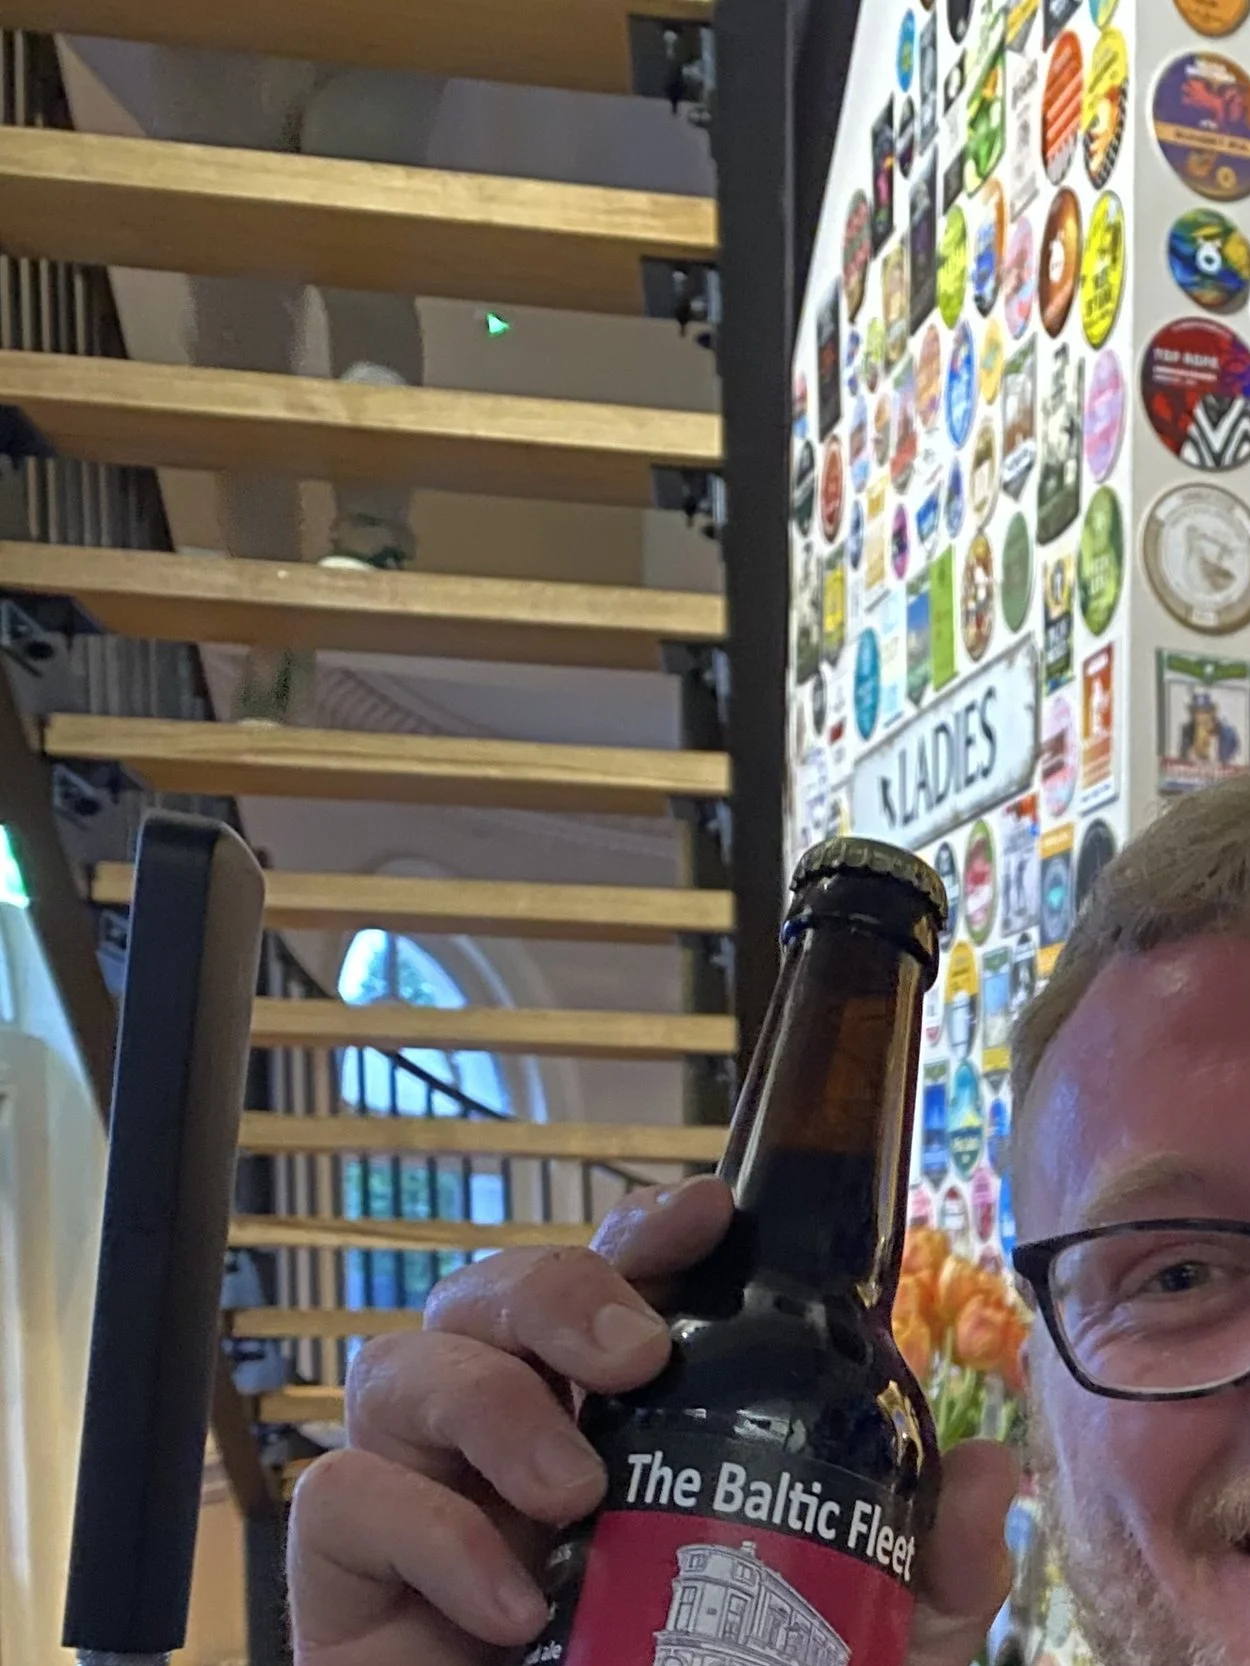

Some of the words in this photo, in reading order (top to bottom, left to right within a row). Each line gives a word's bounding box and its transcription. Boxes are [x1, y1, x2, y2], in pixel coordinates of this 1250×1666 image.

[899, 686, 997, 827] LADIES
[626, 1450, 703, 1506] The
[712, 1461, 841, 1541] Baltic
[847, 1499, 916, 1582] Fleet
